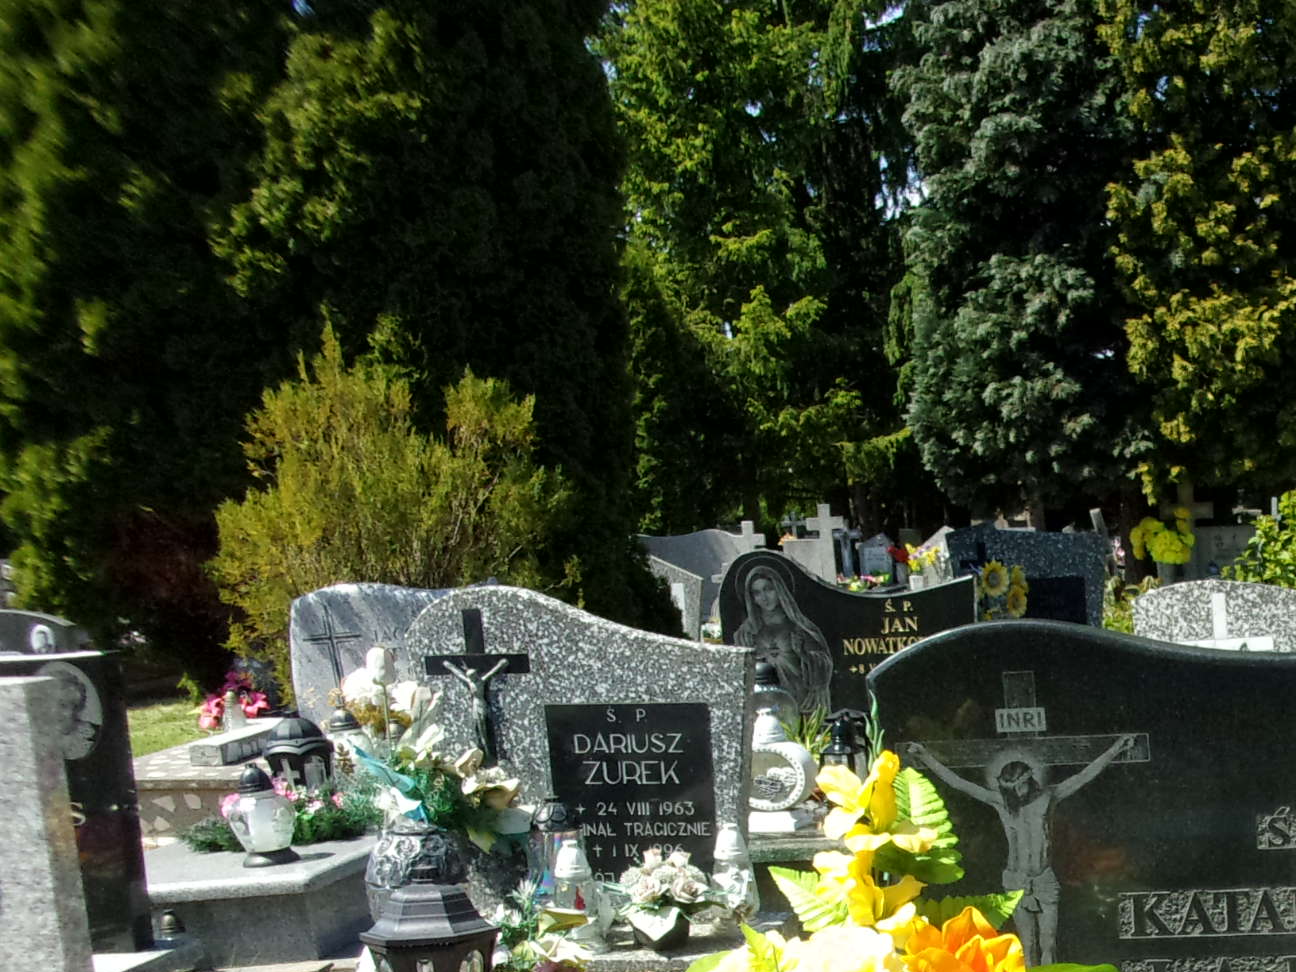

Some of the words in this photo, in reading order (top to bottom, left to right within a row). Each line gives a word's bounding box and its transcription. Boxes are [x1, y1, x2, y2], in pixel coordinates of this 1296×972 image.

[881, 616, 918, 634] JAN
[842, 636, 926, 656] NOWATKO
[1000, 711, 1043, 729] INRI
[573, 732, 684, 755] DARIUSZ
[596, 801, 618, 817] 24
[626, 801, 651, 817] VIII
[658, 800, 695, 817] 1963
[623, 822, 712, 838] TRAGICZNIE
[624, 843, 640, 858] IX
